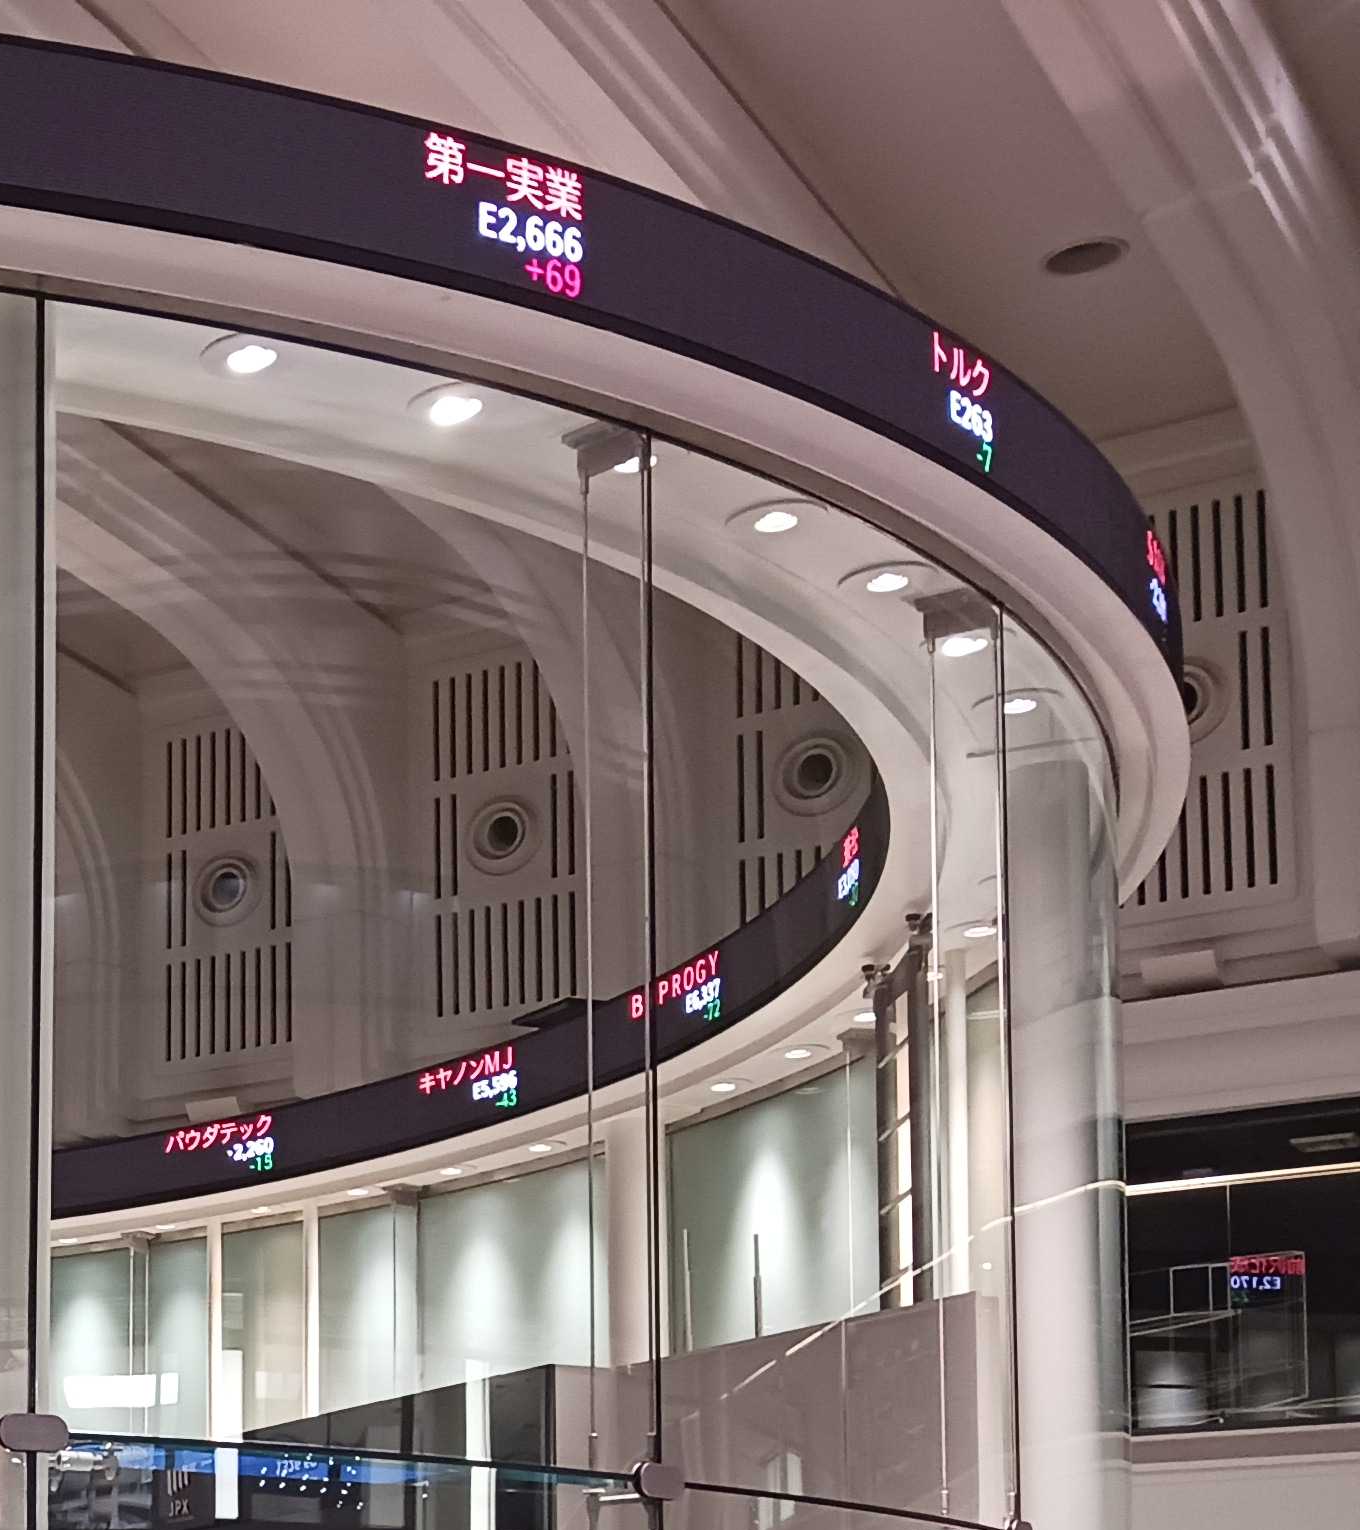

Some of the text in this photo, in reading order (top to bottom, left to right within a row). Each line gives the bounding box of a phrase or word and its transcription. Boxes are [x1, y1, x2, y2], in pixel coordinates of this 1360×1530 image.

[424, 131, 583, 221] 第一実業
[478, 200, 584, 263] E2,666
[525, 258, 581, 298] +69
[933, 331, 990, 397] トルク
[949, 389, 993, 443] E263
[976, 441, 993, 473] -7
[632, 951, 719, 1018] BPROGY
[419, 1046, 513, 1095] キヤノンMJ
[164, 1114, 273, 1154] パウダテック
